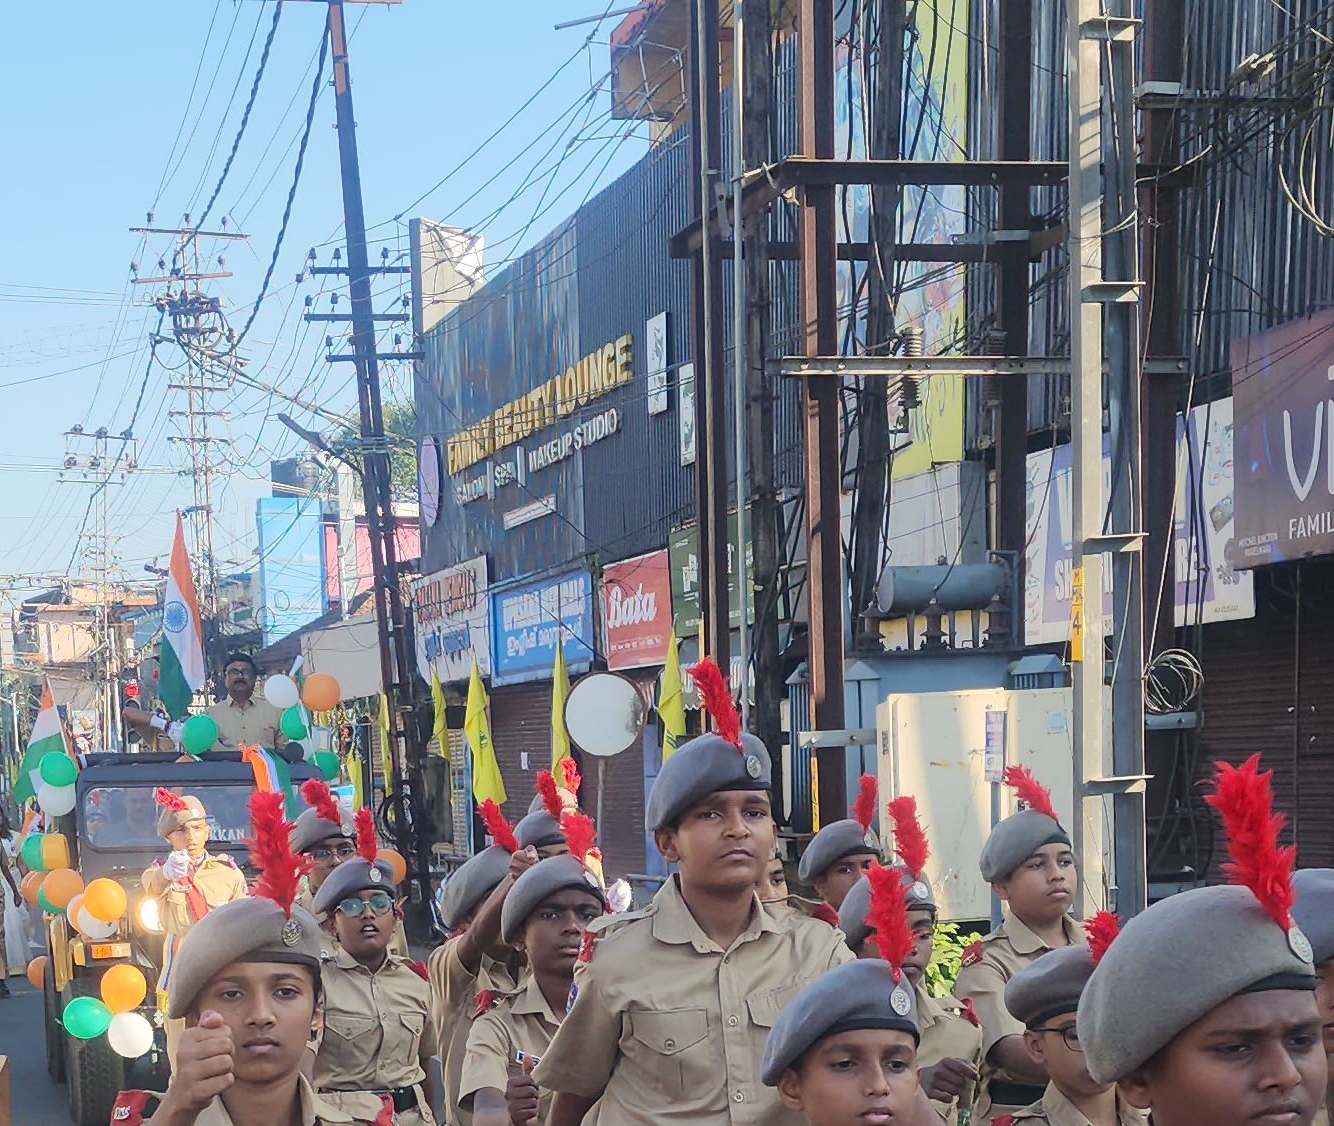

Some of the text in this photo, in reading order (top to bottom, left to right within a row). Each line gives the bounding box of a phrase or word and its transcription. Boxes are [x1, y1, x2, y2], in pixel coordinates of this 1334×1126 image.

[447, 334, 633, 476] FAMILY BEAUTY LOUNGE
[529, 433, 573, 472] MAKEUP
[574, 408, 620, 450] STUDIO
[608, 583, 658, 629] Bata
